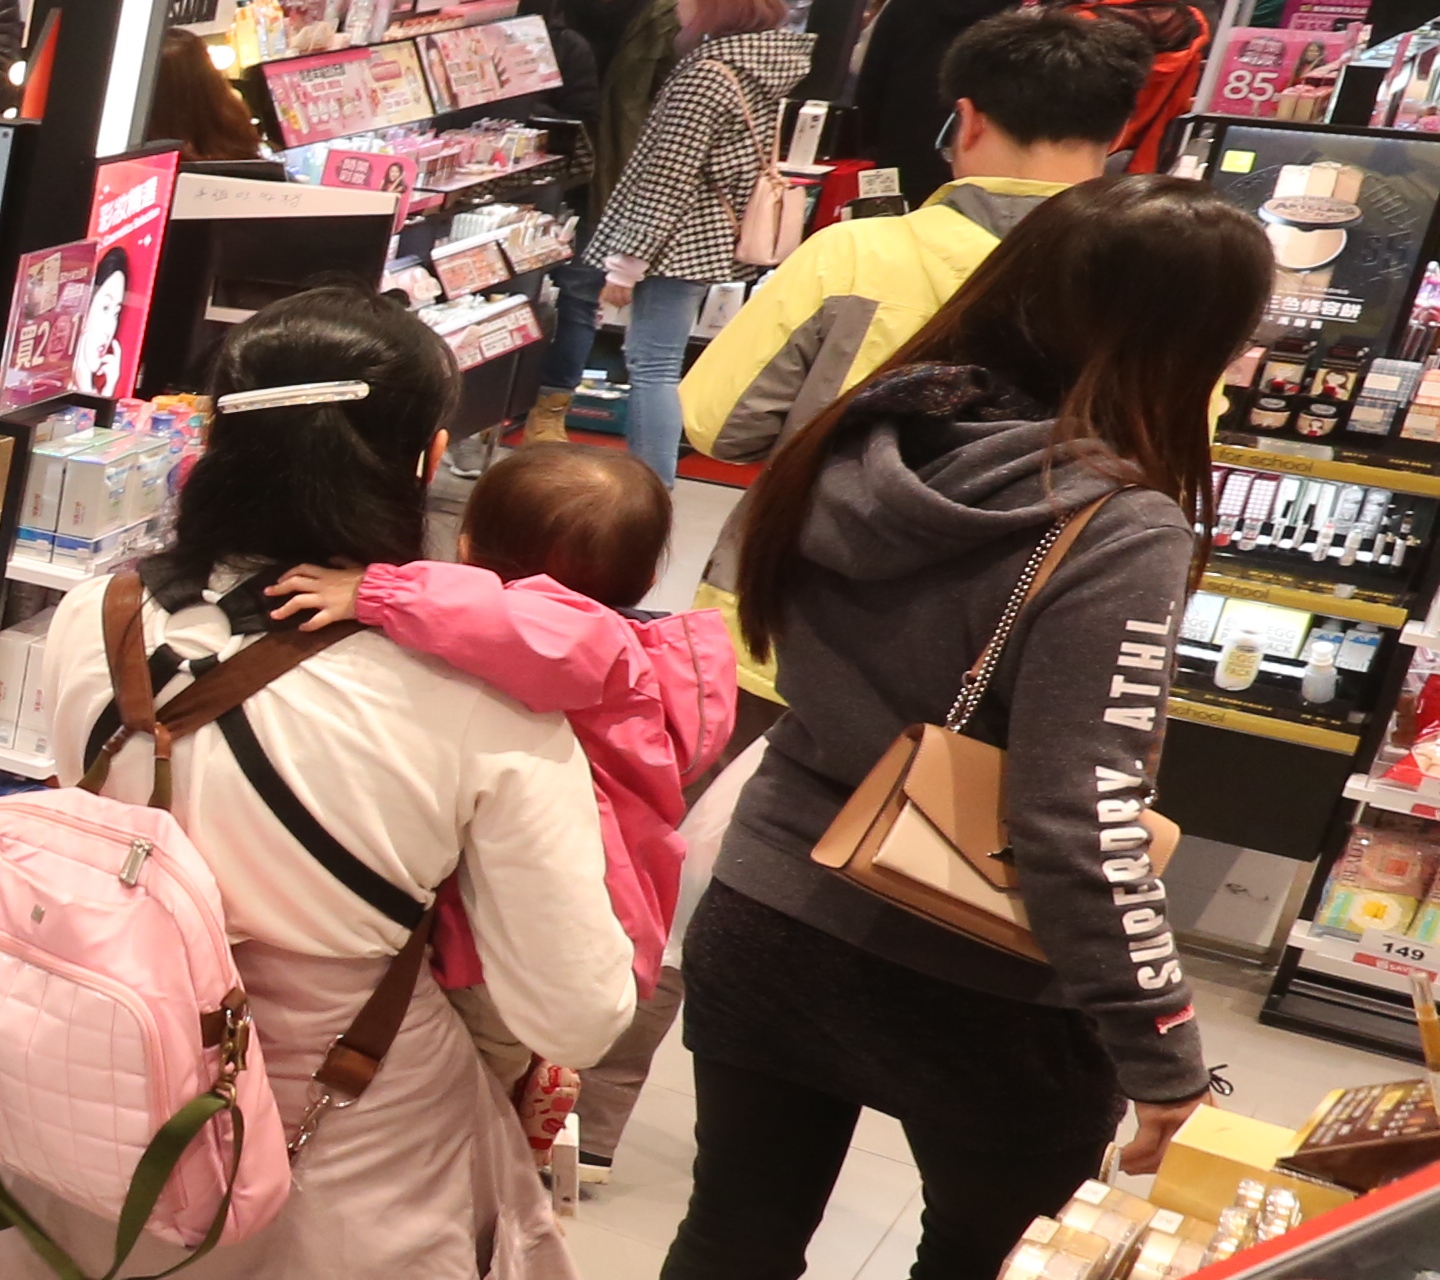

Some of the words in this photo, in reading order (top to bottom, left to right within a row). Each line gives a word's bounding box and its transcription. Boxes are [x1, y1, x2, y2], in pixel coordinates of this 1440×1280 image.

[1248, 451, 1315, 475] school
[1208, 580, 1269, 602] school
[1104, 602, 1177, 732] ATHL.
[1094, 758, 1183, 992] SUPERDRY.
[1382, 941, 1425, 962] 149
